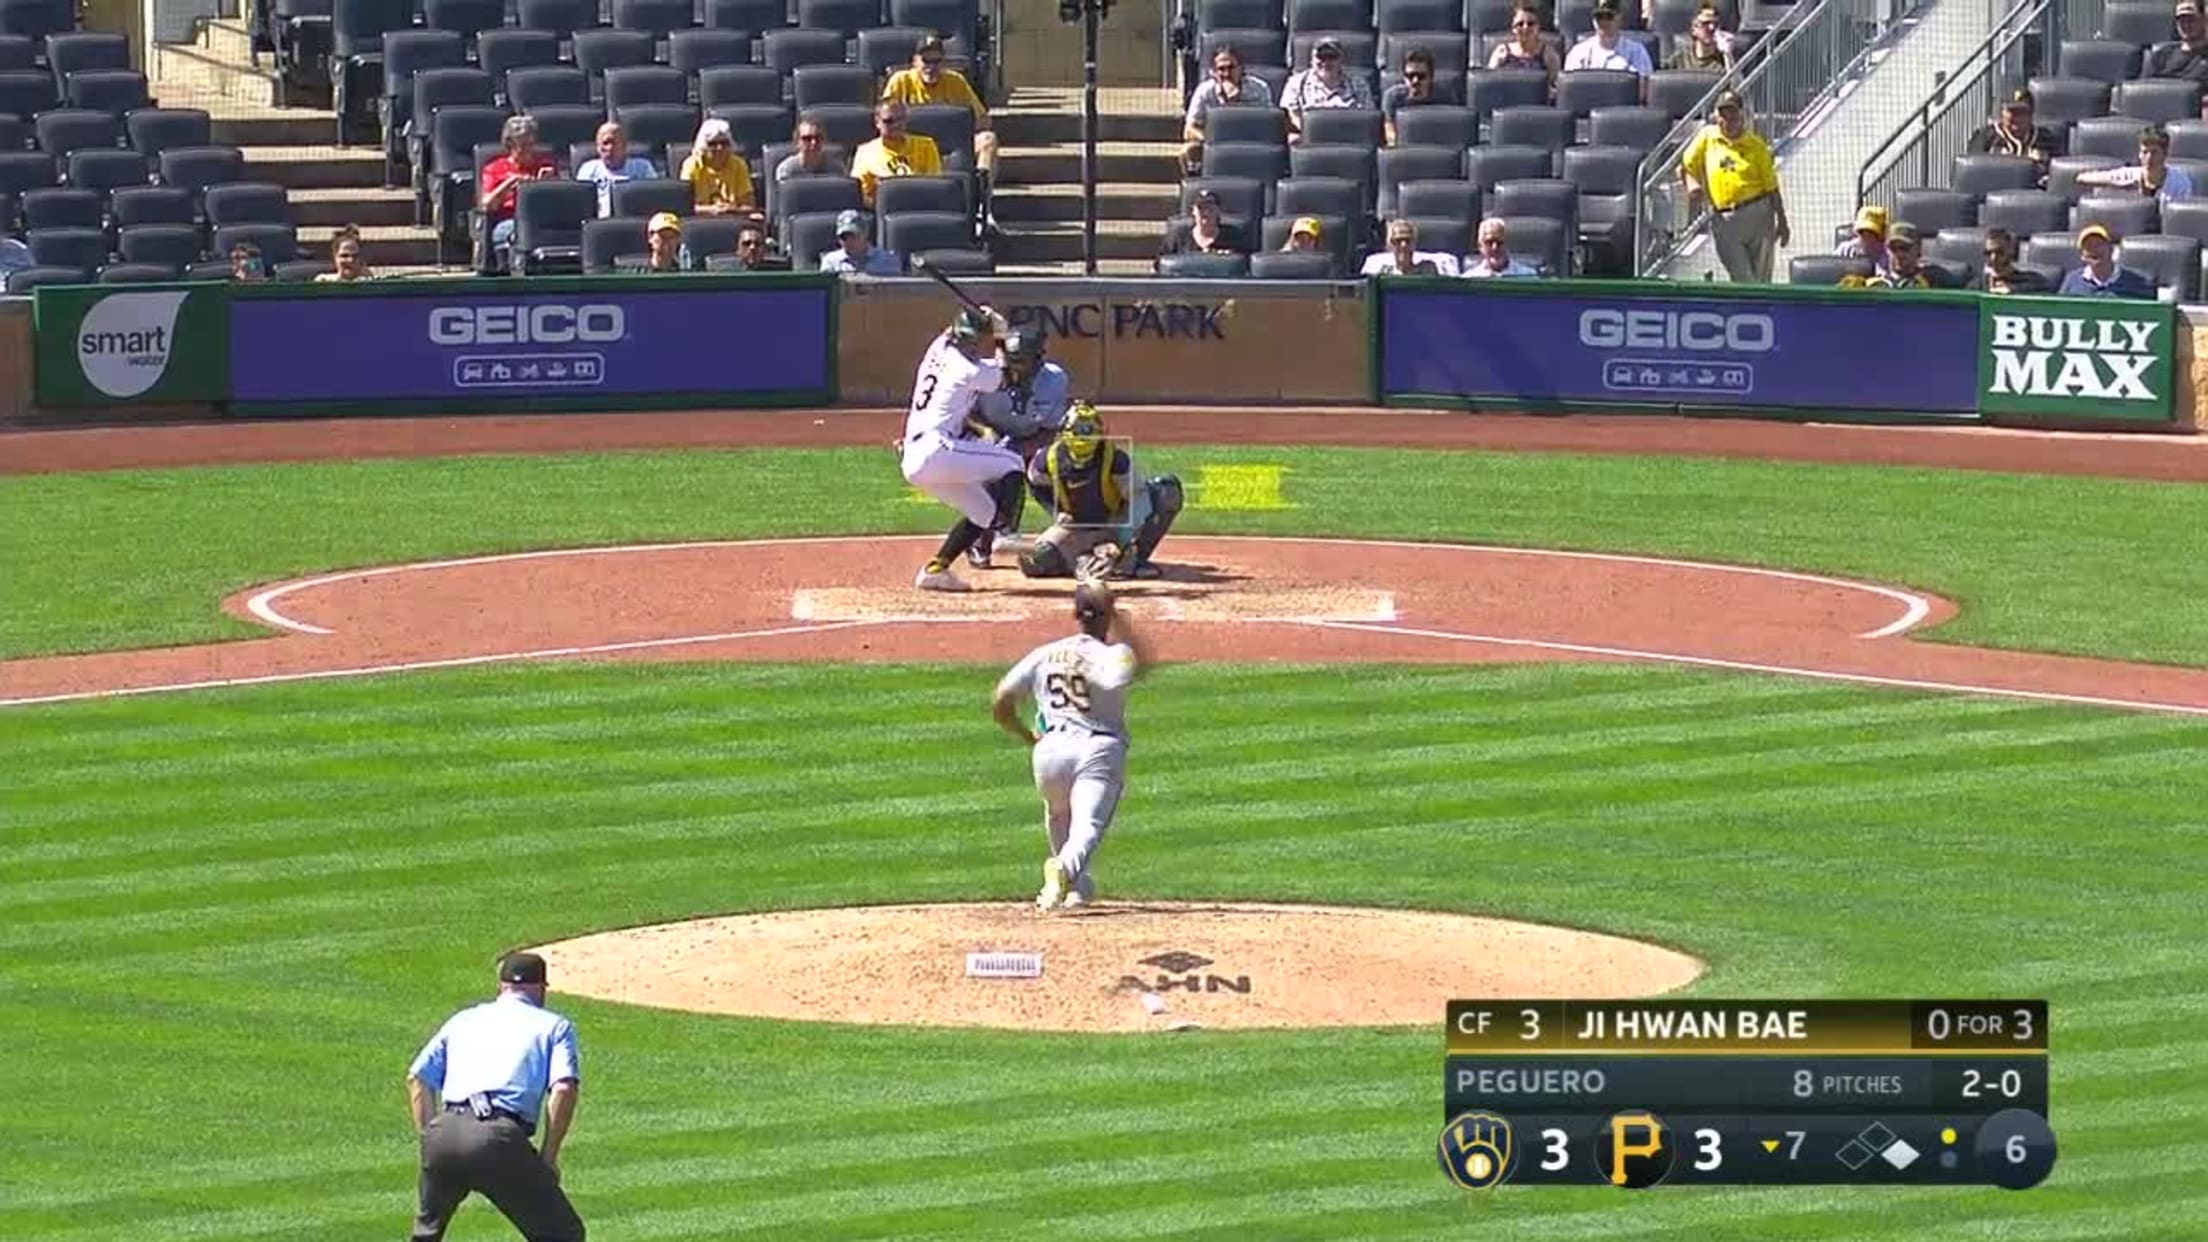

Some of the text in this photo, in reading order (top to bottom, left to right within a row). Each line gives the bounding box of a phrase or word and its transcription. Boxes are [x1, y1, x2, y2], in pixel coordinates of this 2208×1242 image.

[82, 326, 166, 354] smart
[429, 304, 625, 344] GEICO
[1008, 303, 1225, 339] PNC PARK
[1579, 309, 1774, 351] GEICO
[1992, 315, 2160, 353] BULLY
[915, 374, 938, 411] 3
[1988, 350, 2159, 400] MAX
[1047, 673, 1091, 713] 59
